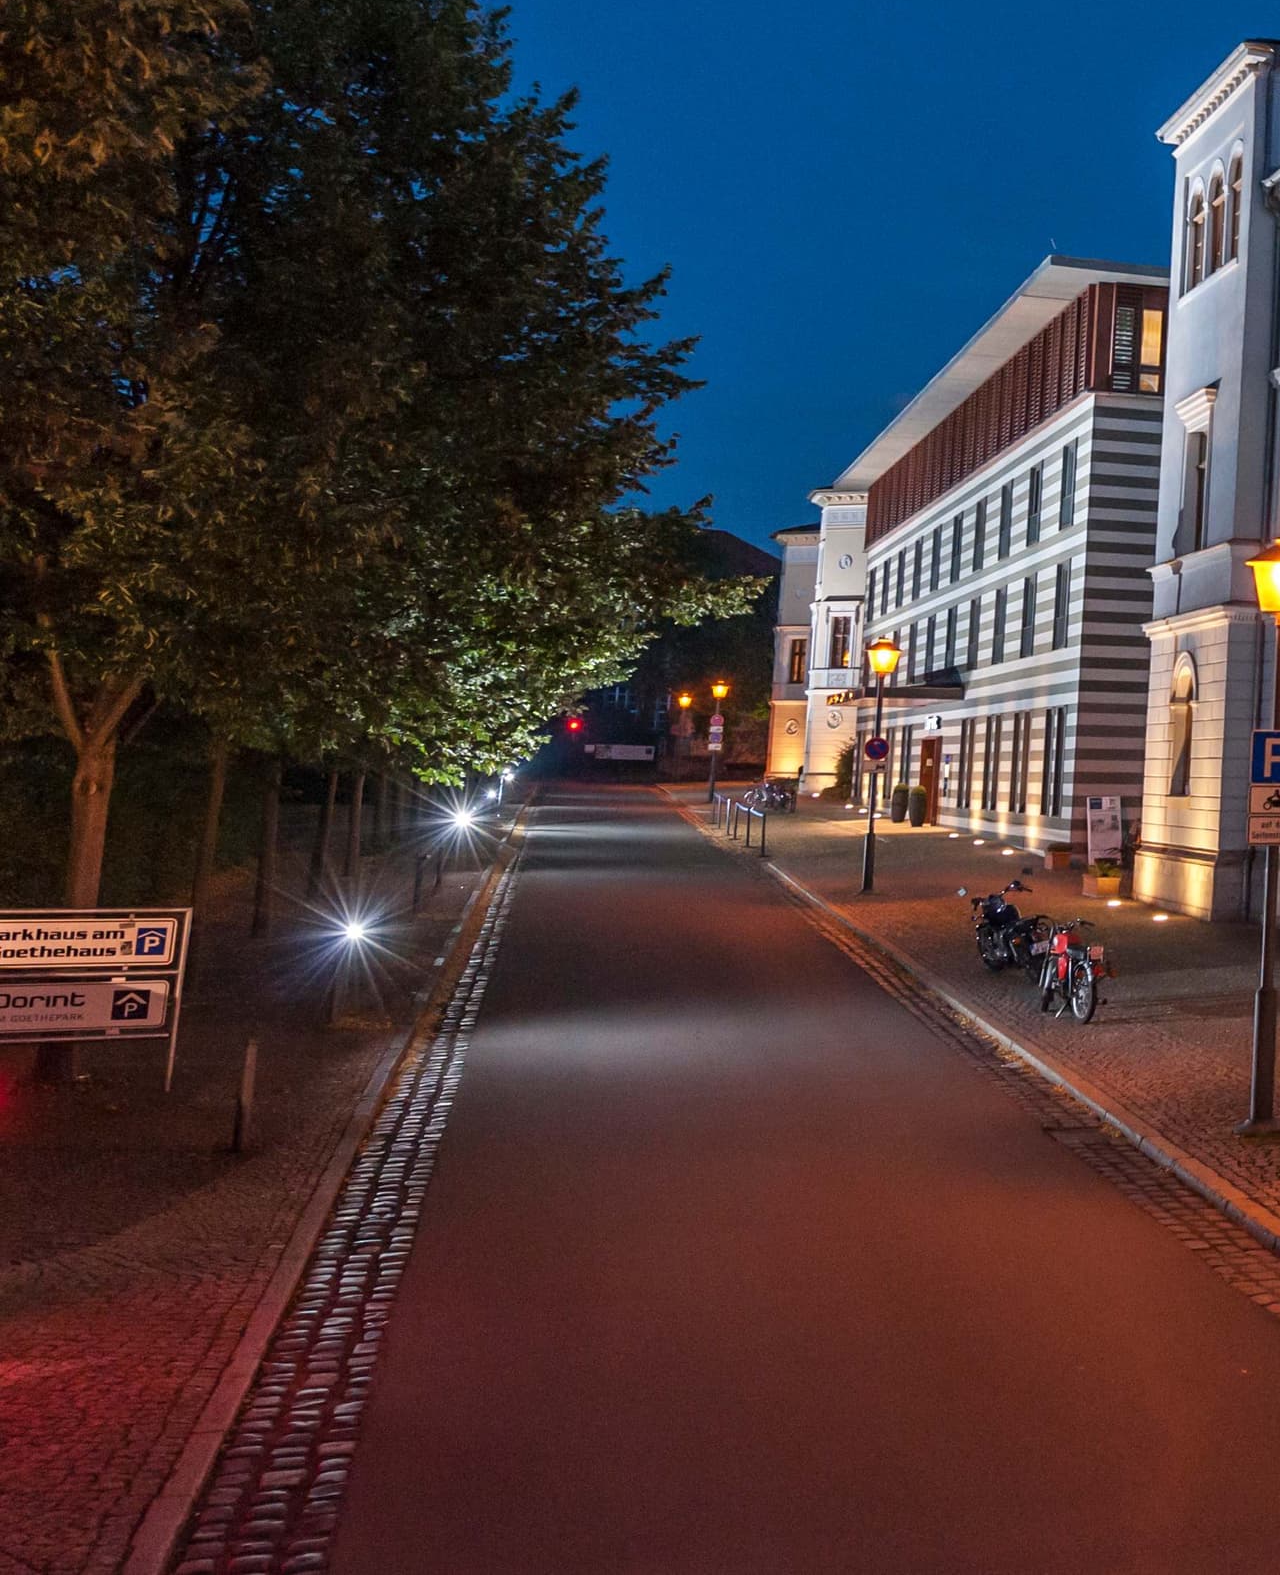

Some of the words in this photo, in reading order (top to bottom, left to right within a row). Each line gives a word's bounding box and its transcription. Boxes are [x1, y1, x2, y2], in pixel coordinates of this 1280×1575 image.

[0, 928, 88, 941] arkhaus
[92, 930, 125, 940] am
[0, 945, 117, 959] oethehaus
[143, 936, 161, 954] P
[124, 1002, 138, 1018] P
[10, 1012, 85, 1023] GOETHEPARK
